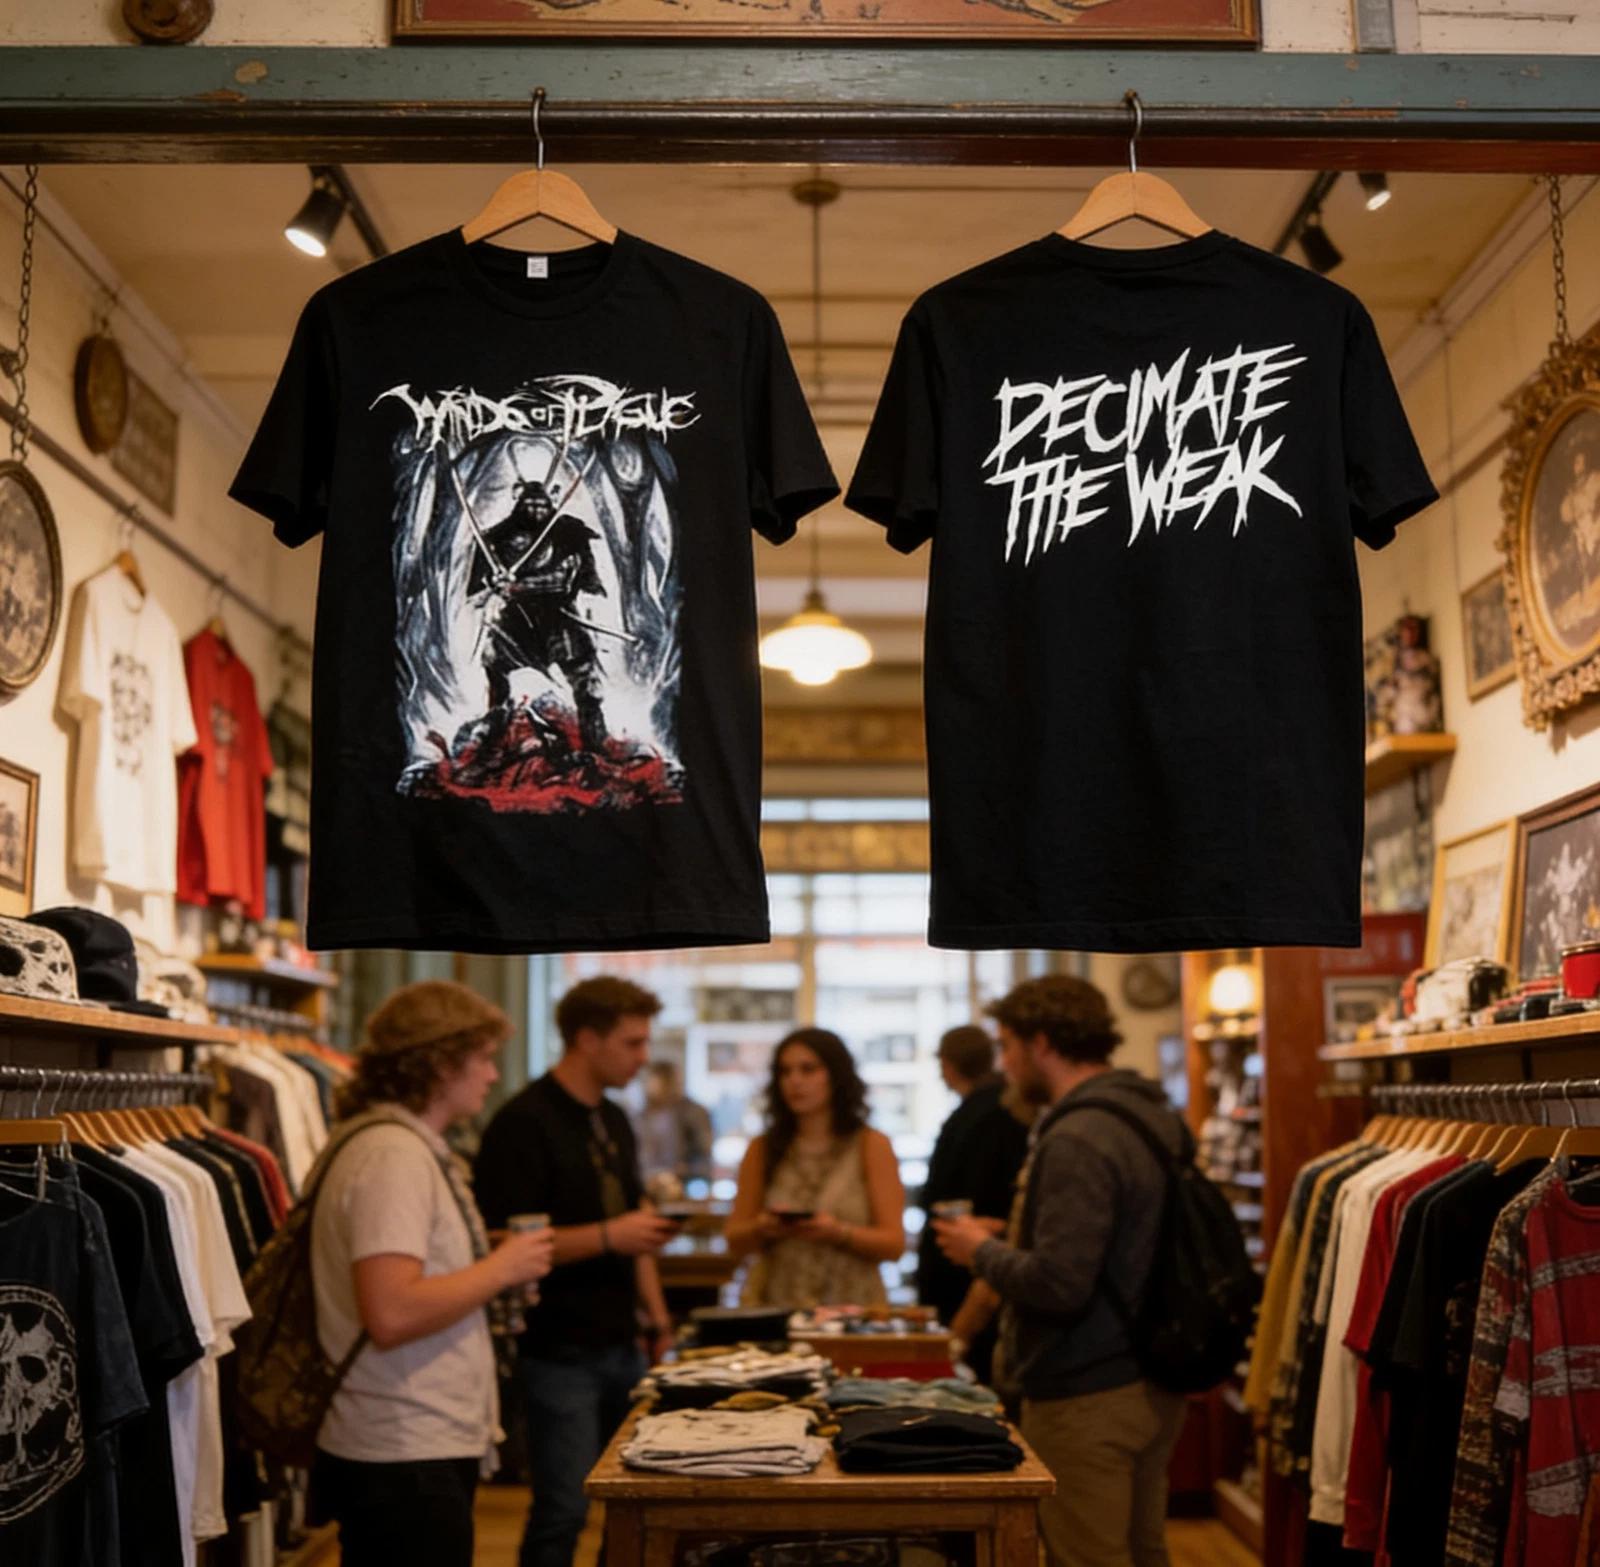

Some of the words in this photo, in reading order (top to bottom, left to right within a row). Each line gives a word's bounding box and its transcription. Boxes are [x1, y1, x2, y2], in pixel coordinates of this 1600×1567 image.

[981, 343, 1308, 475] DECIMATE
[984, 453, 1126, 567] THE
[1125, 424, 1303, 548] WEAK
